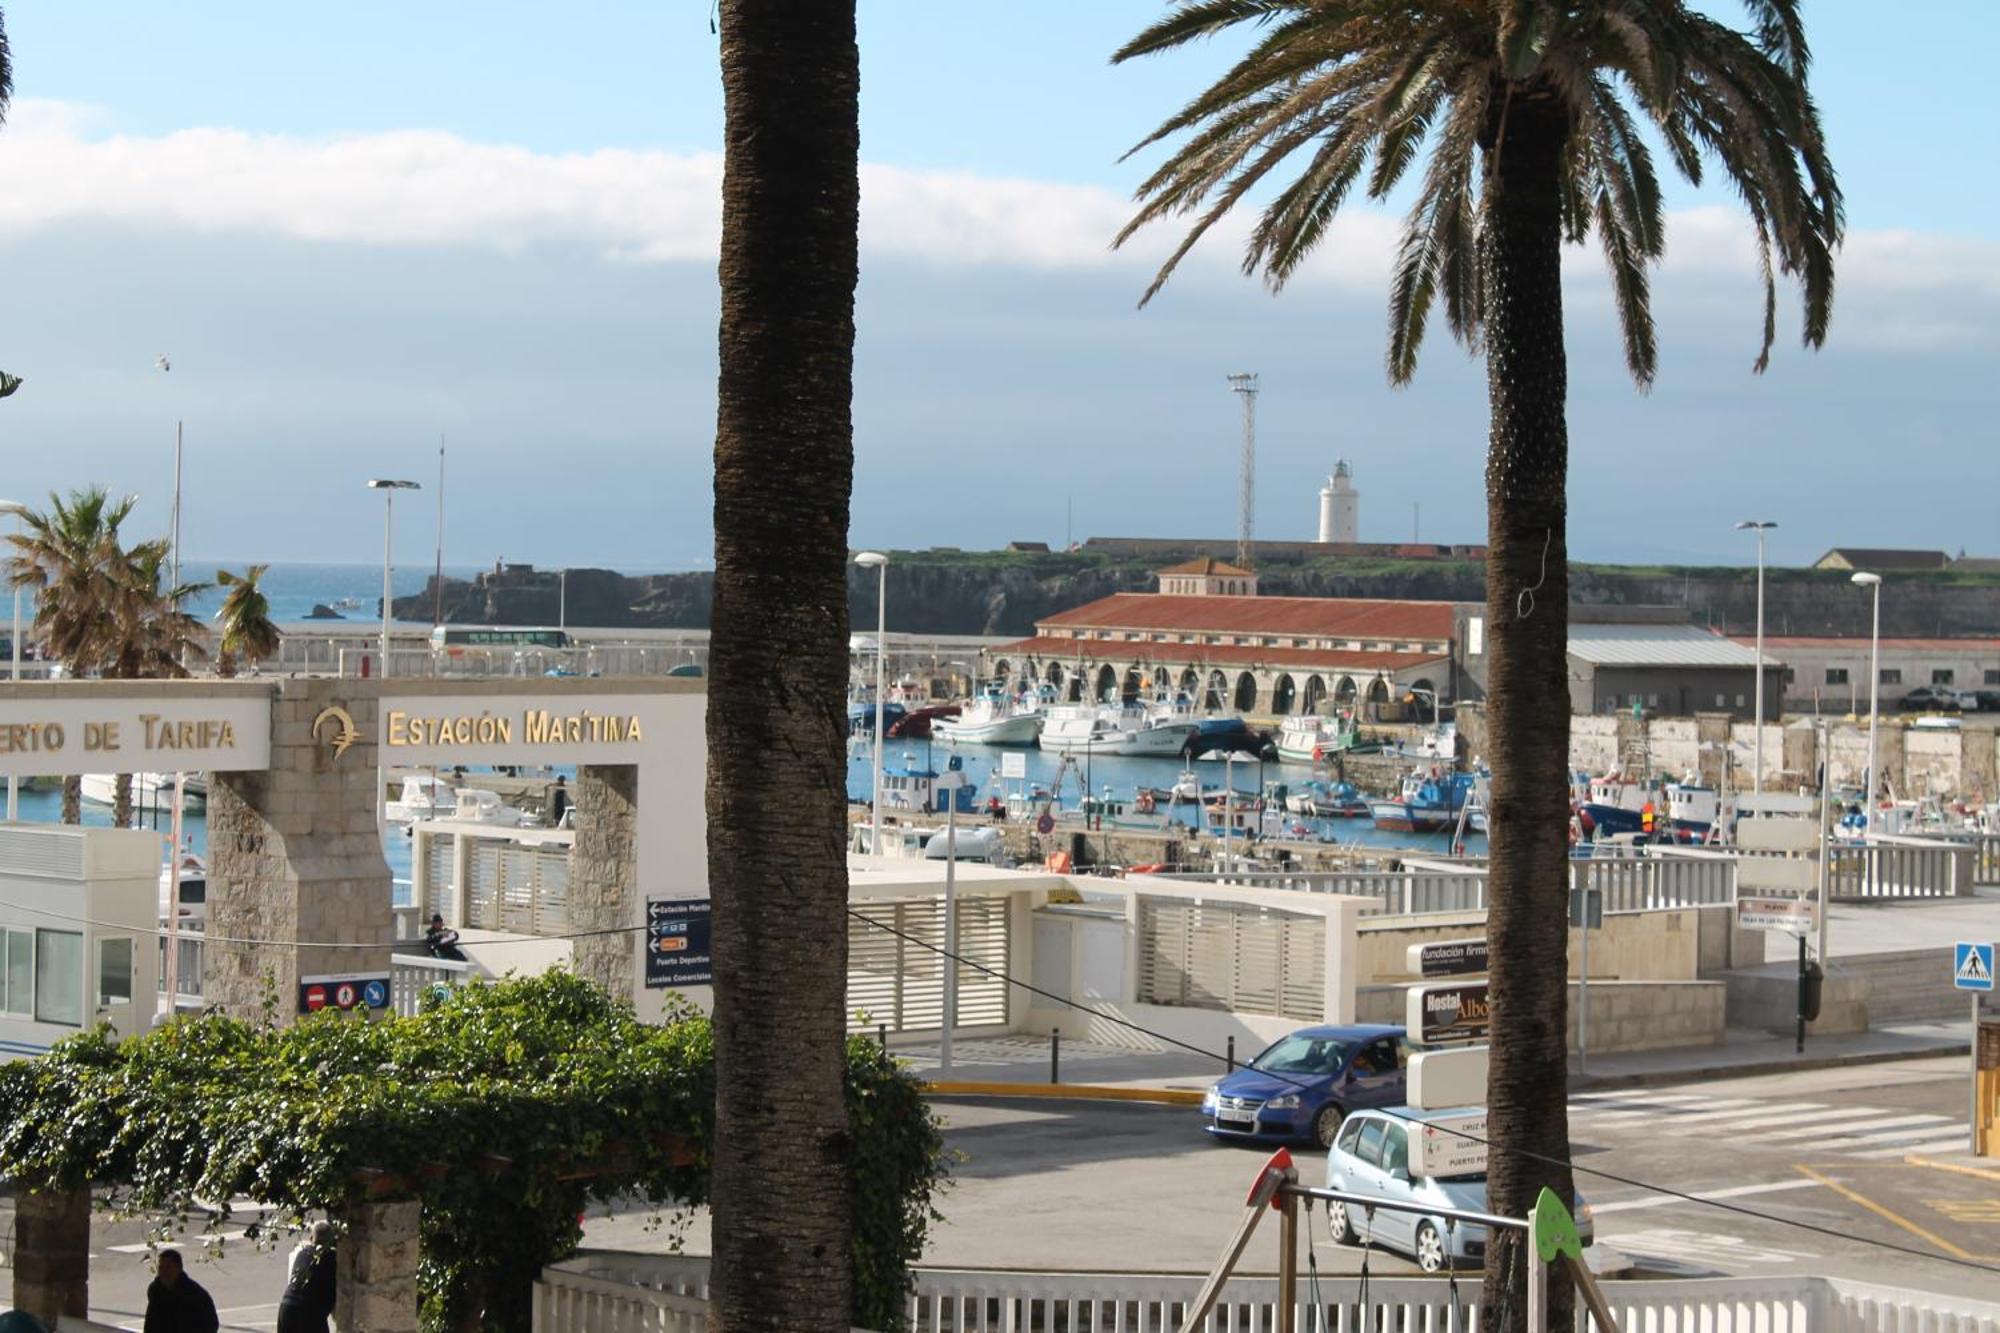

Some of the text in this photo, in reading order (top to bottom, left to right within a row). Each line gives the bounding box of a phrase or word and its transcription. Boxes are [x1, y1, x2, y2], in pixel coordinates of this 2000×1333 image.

[84, 722, 121, 750] DE
[139, 714, 236, 750] TARIFA
[387, 709, 642, 746] ESTACIÓN MARÍTIMA
[656, 957, 678, 966] Puerto
[1427, 992, 1461, 1012] Hostal
